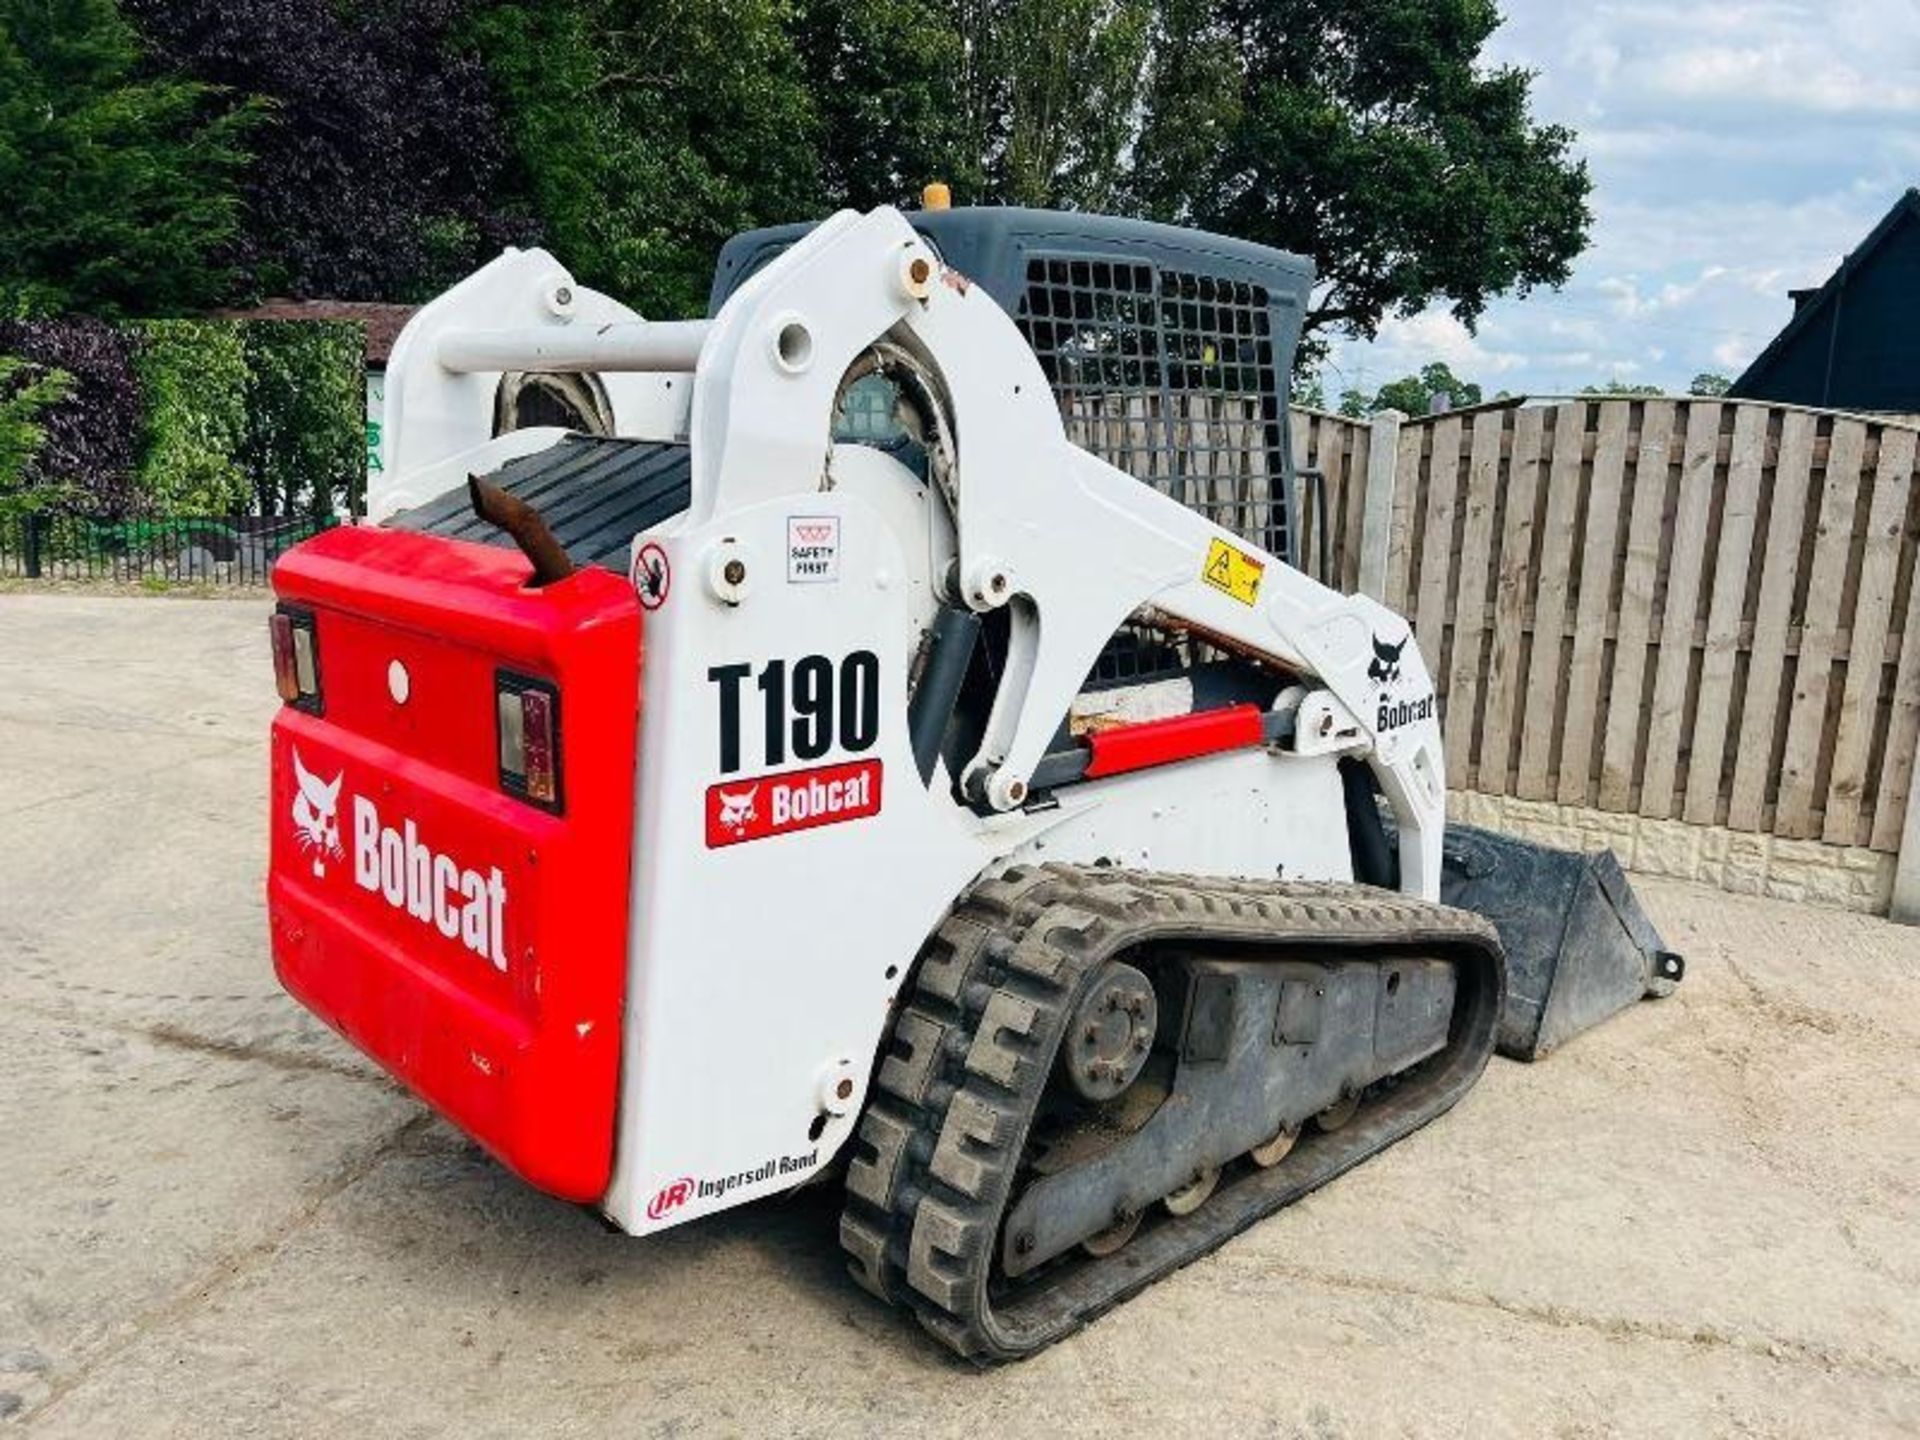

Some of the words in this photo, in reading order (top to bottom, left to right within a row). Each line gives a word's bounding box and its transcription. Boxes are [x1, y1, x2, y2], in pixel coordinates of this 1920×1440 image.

[791, 546, 834, 559] SAFETY
[796, 561, 829, 574] FIRST
[708, 650, 879, 774] T190
[1377, 694, 1433, 733] Bobcat
[771, 770, 870, 826] Bobcat
[353, 794, 508, 973] Bobcat
[698, 1160, 776, 1198] Ingersoll
[779, 1149, 818, 1175] Rand
